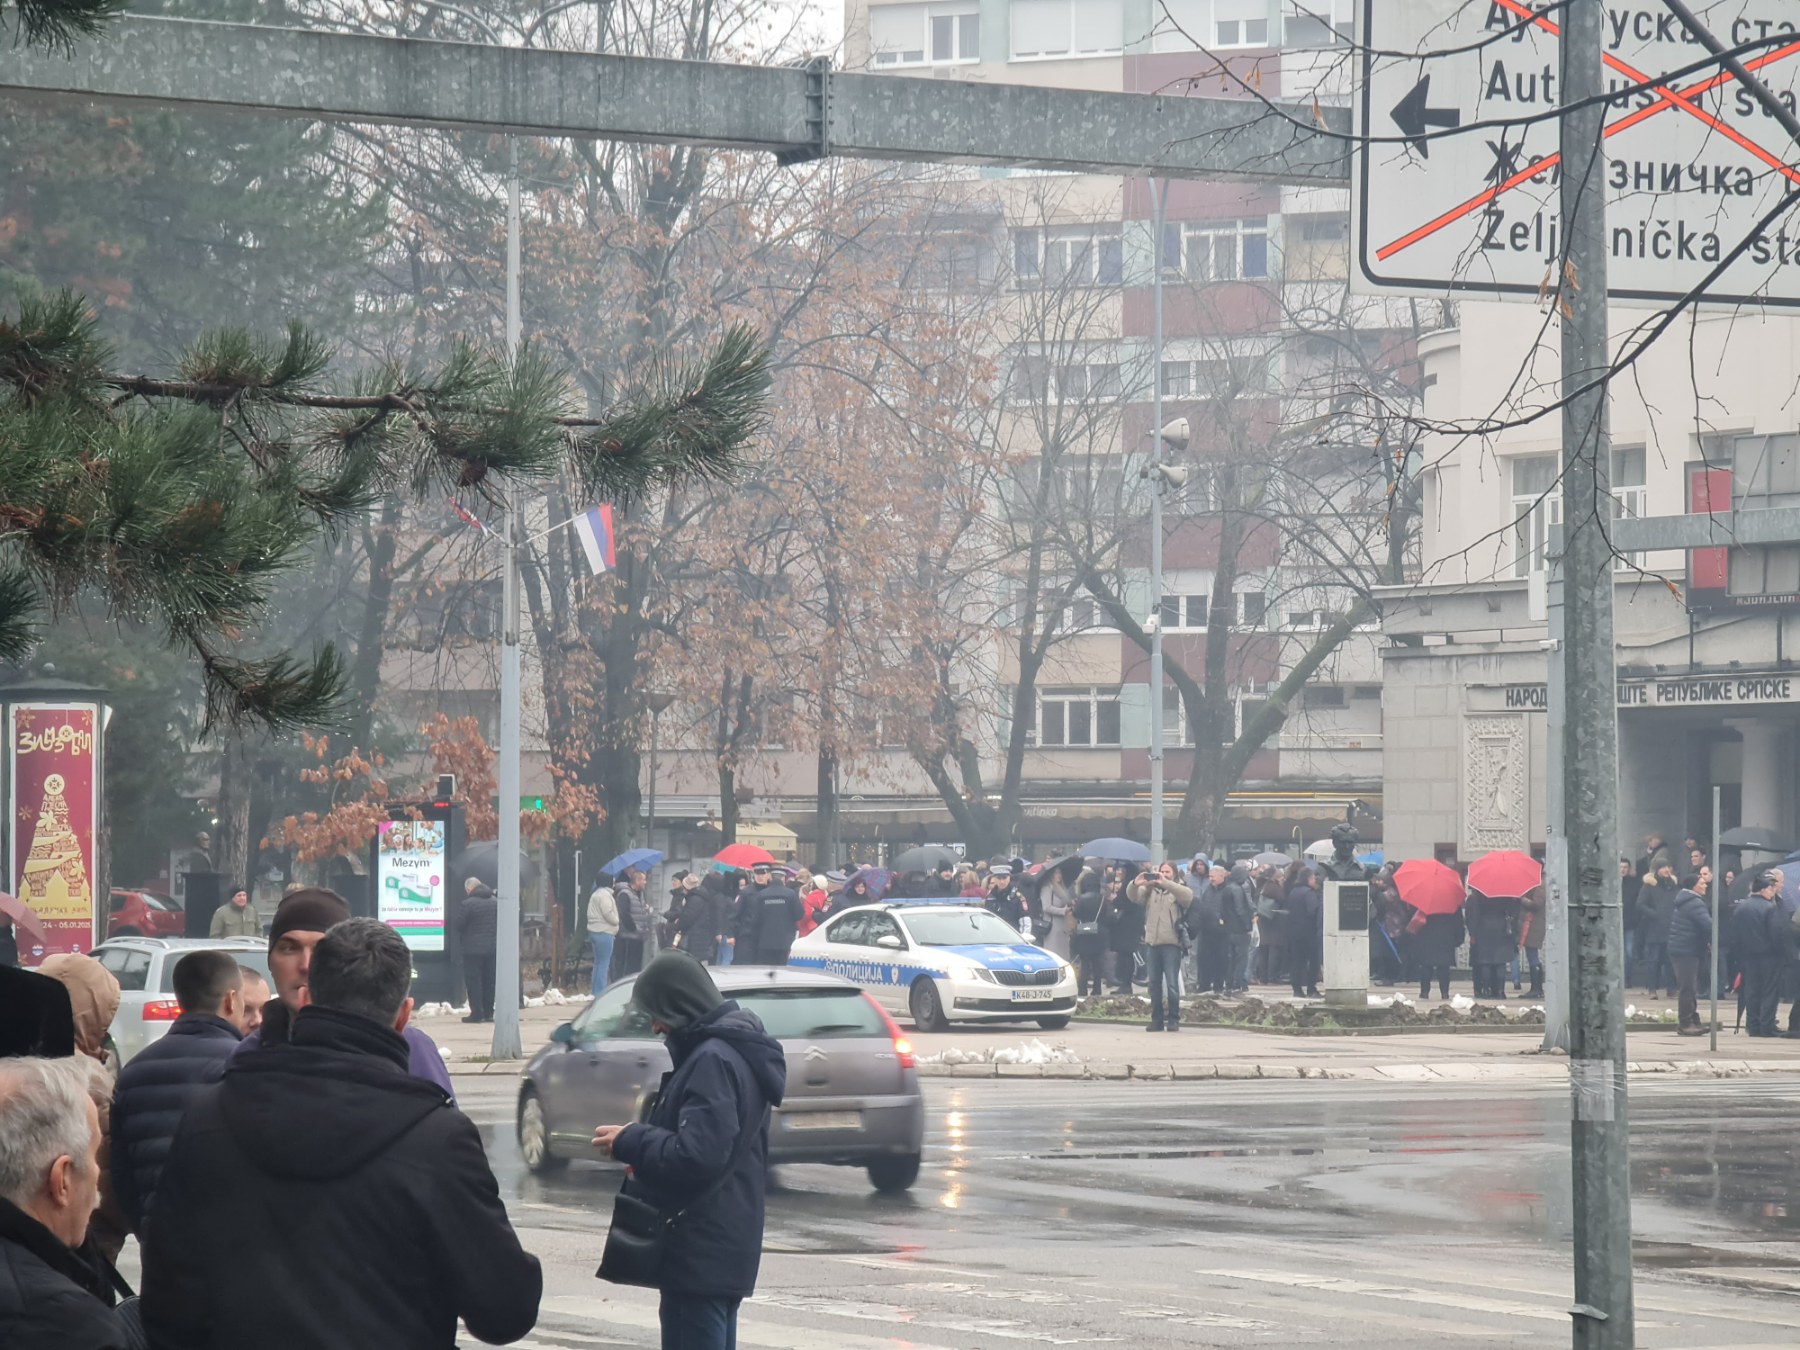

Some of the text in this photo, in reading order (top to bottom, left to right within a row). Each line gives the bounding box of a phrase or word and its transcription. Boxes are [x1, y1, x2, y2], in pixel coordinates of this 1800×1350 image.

[1483, 140, 1753, 196] Жезничка
[1751, 226, 1800, 266] st
[1656, 681, 1732, 702] РЕПУБЛИКЕ
[1737, 679, 1790, 700] СРПСКЕ
[392, 857, 430, 869] Mezym
[833, 962, 883, 982] ПОЛИЦИЈА
